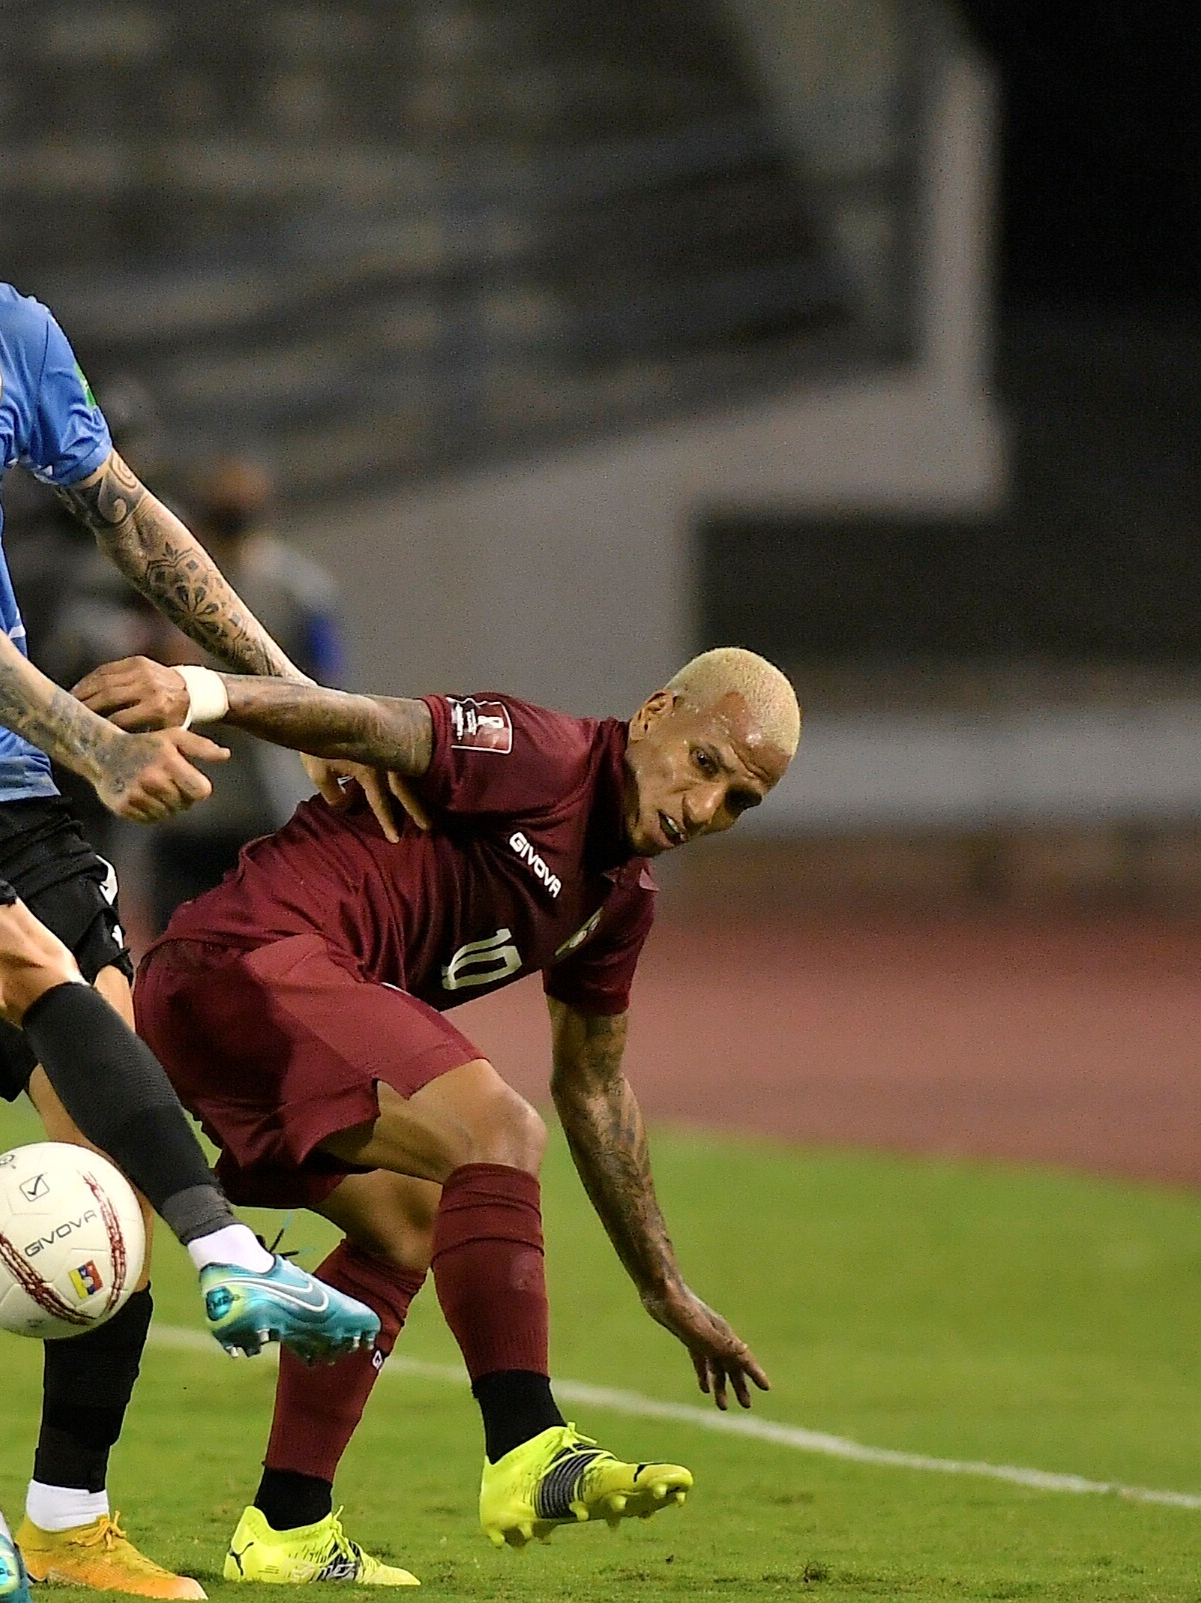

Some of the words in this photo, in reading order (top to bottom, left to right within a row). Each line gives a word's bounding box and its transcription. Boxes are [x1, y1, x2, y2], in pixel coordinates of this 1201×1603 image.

[509, 831, 562, 898] GIVOVA
[442, 928, 522, 990] 10
[24, 1209, 98, 1258] GIVOVA
